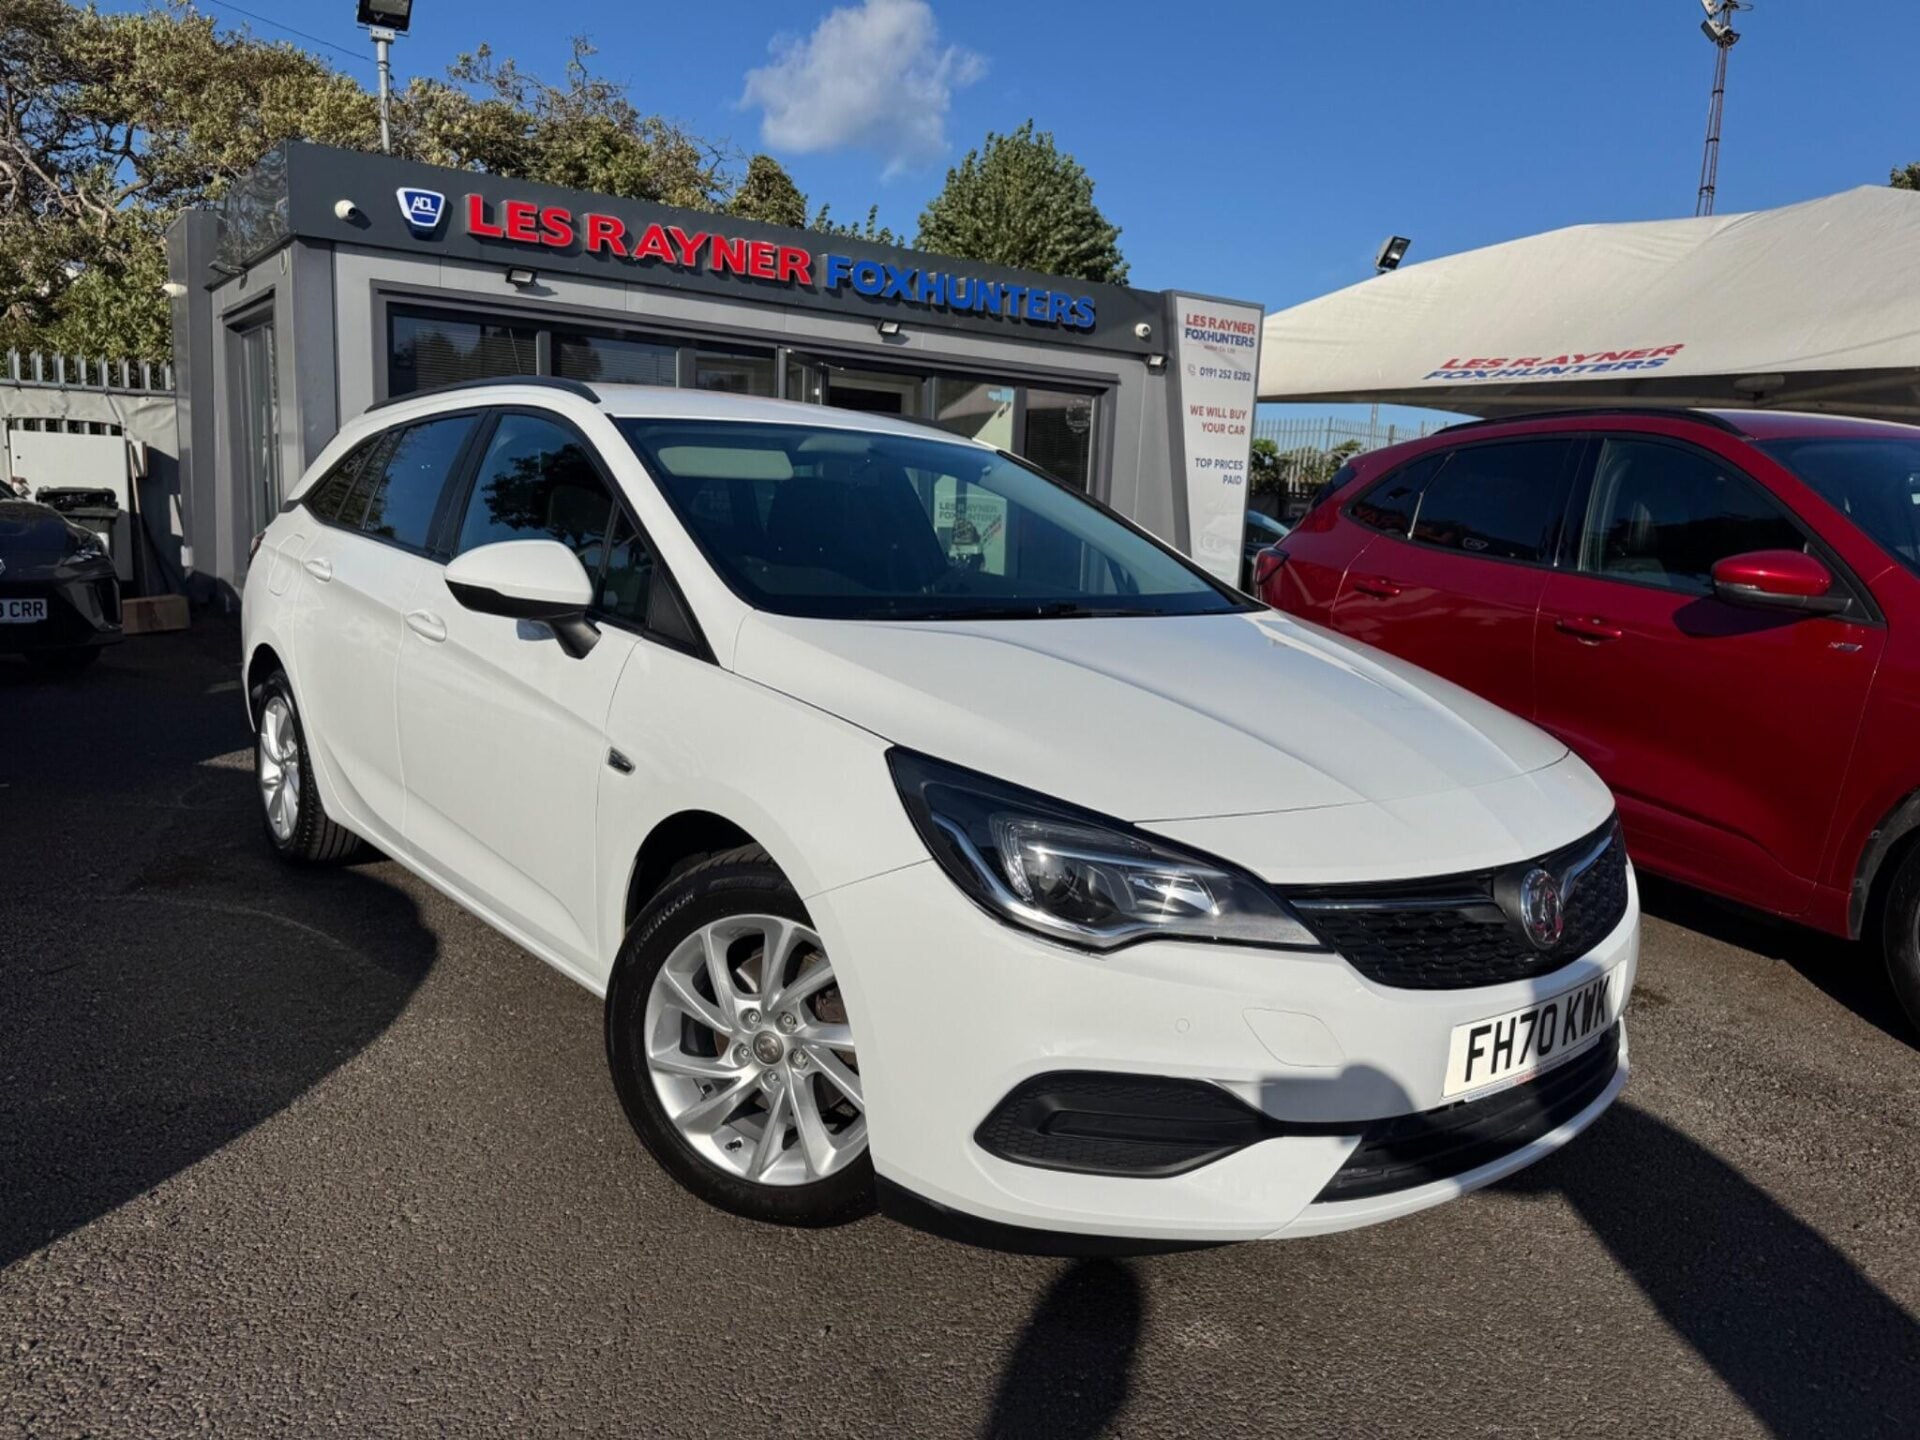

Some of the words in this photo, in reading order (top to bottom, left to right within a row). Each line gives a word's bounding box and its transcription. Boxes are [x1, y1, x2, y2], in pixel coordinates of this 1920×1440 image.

[466, 193, 574, 247] LES
[585, 213, 812, 285] RAYNER
[823, 254, 1096, 328] FOXHUNTERS
[1186, 313, 1206, 328] LES
[1208, 316, 1256, 335] RAYNER
[1184, 327, 1255, 348] FOXHUNTERS
[1440, 358, 1508, 369] LES
[1509, 344, 1685, 368] RAYNER
[1200, 366, 1217, 379] 0191
[1218, 369, 1232, 380] 252
[1422, 357, 1670, 380] FOXHUNTERS
[1190, 404, 1204, 416] WE
[1206, 405, 1227, 419] WILL
[1229, 408, 1248, 420] BUY
[1201, 422, 1226, 434] YOUR
[1228, 424, 1246, 436] CAR
[1195, 457, 1212, 468] TOP
[1214, 459, 1244, 471] PRICES
[1222, 474, 1242, 486] PAID
[9, 601, 44, 618] CRR
[1464, 1003, 1558, 1083] FH70
[1562, 975, 1611, 1047] KWK
